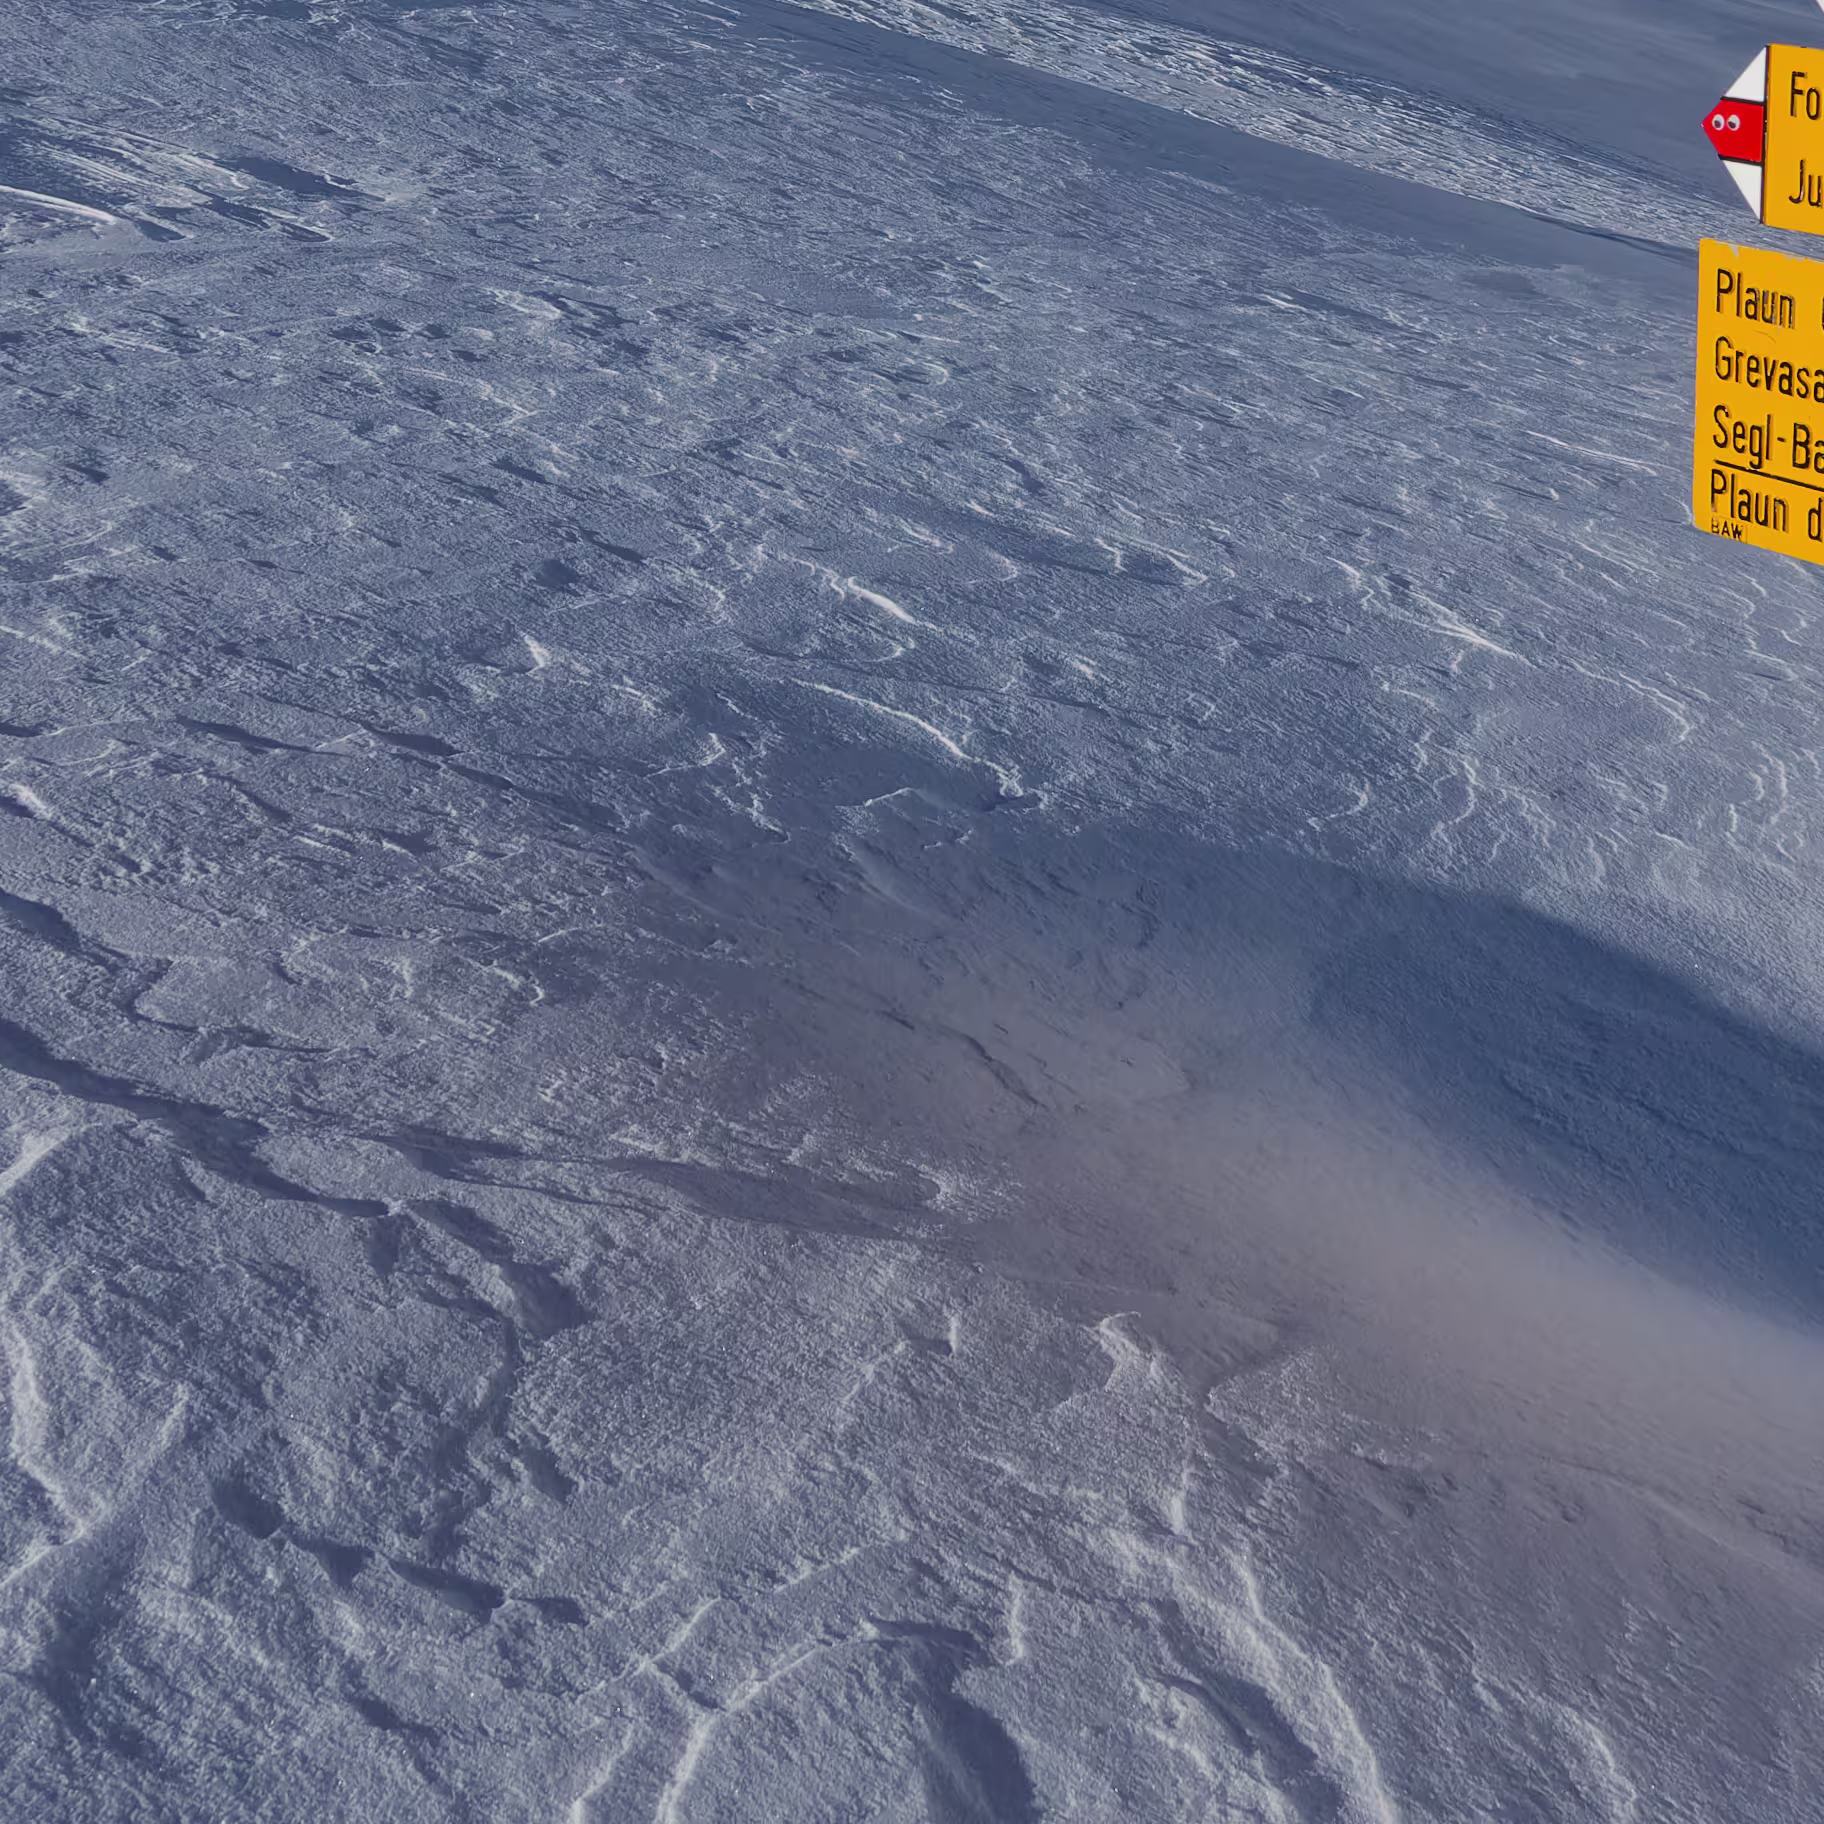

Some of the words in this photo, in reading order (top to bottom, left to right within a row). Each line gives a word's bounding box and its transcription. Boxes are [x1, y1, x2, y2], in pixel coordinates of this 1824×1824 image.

[1716, 267, 1795, 329] Plaun
[1710, 467, 1790, 534] Plaun
[1710, 518, 1745, 543] BAW
